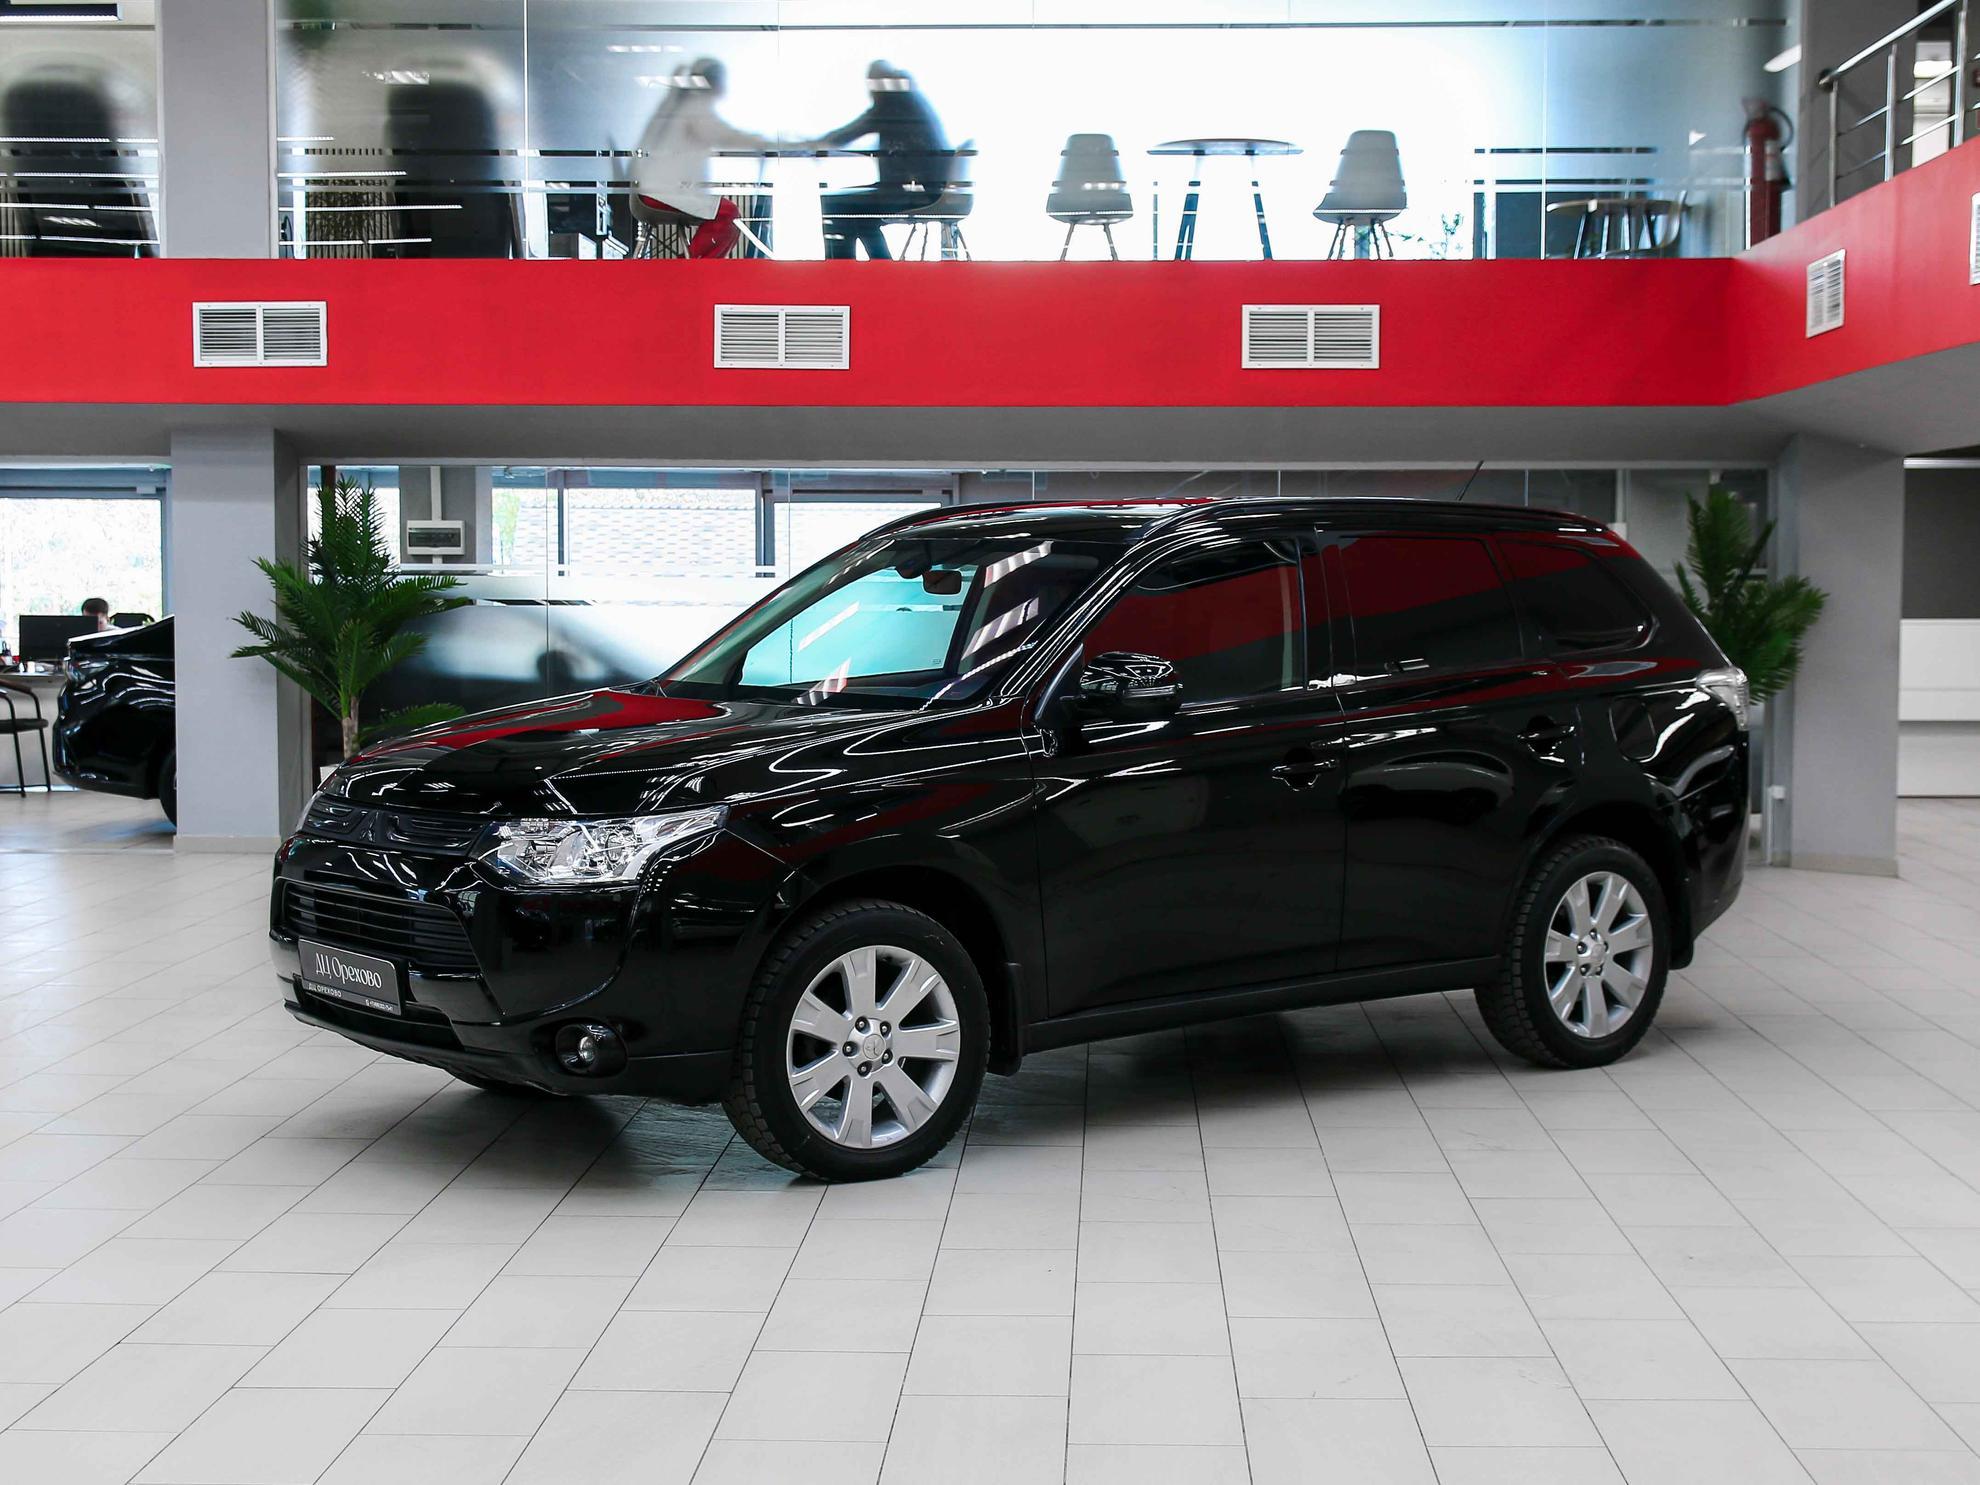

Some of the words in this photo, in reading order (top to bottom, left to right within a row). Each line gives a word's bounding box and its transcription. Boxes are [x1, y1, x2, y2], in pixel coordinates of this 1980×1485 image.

[316, 952, 332, 979] ДЦ
[332, 957, 382, 989] Орехово
[317, 985, 342, 998] ОРЕХОВО
